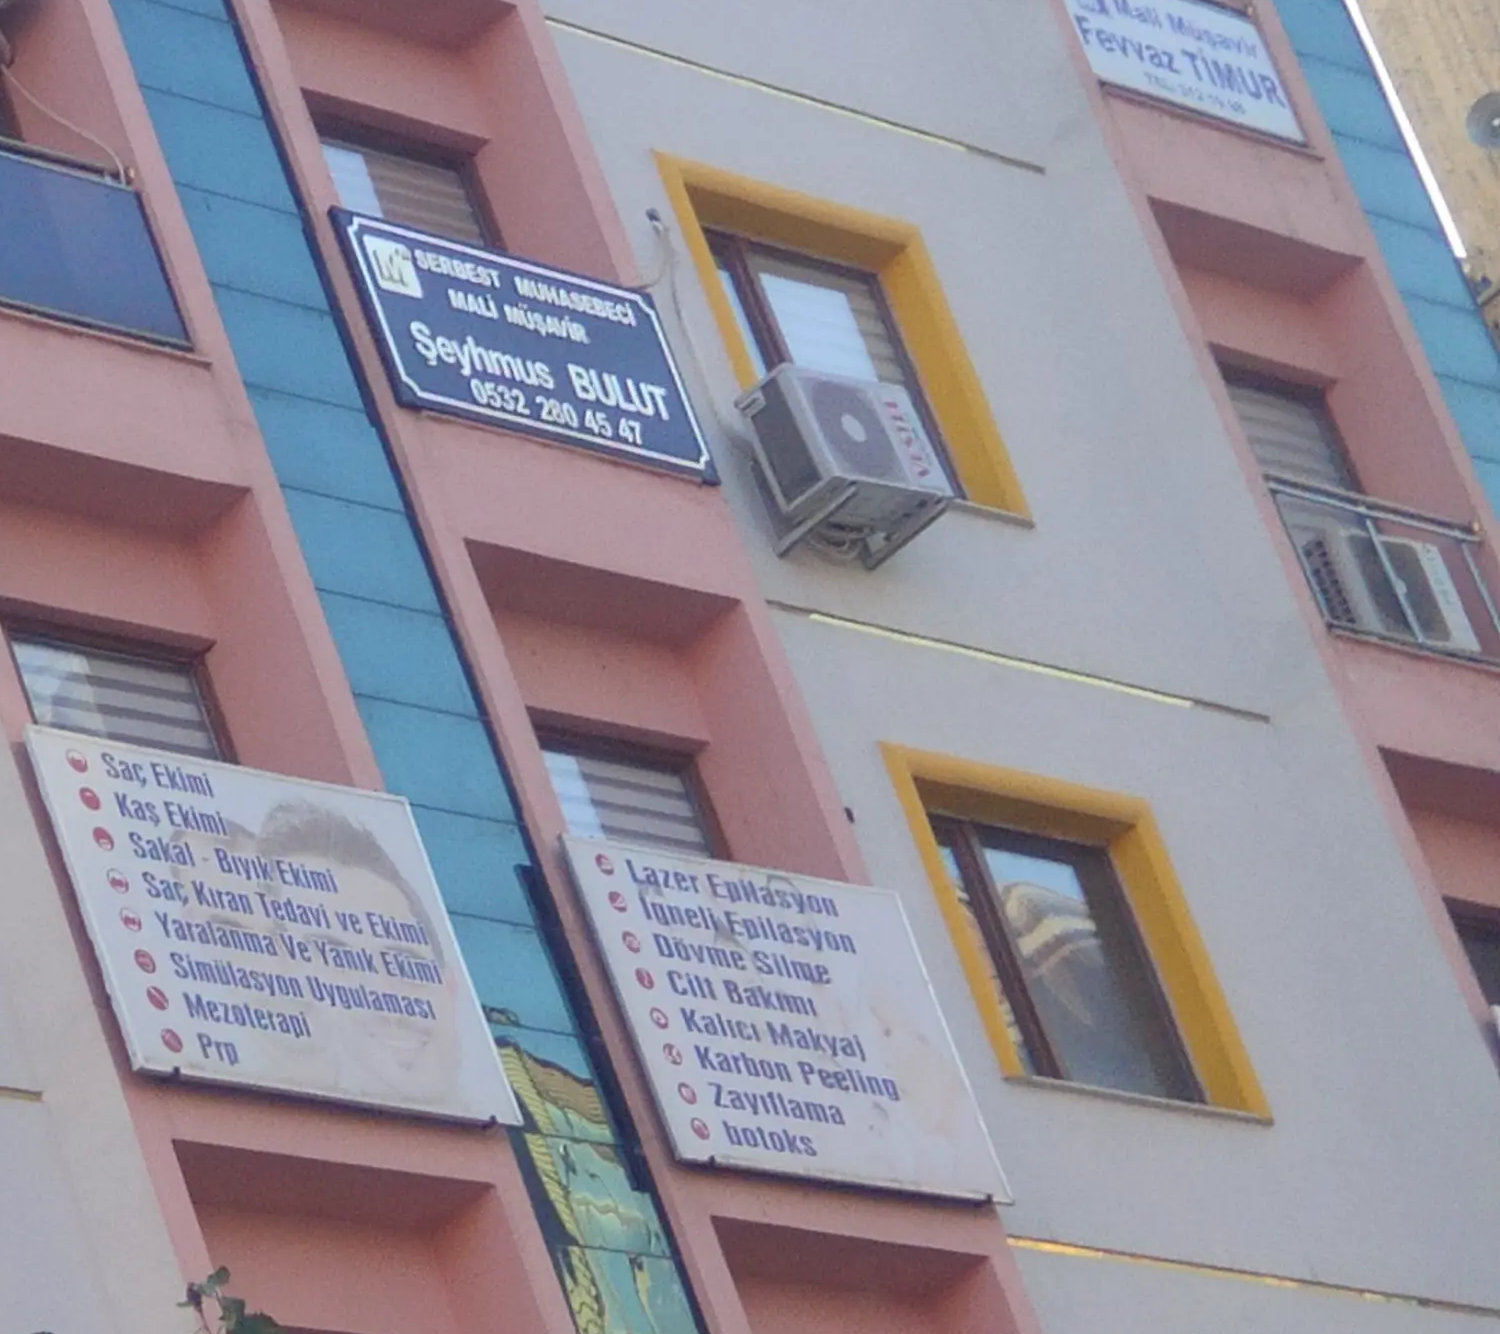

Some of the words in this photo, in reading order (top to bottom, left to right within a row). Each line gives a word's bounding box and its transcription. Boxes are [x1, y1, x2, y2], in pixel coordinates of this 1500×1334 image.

[414, 250, 500, 288] SERBEST
[515, 275, 637, 327] MUHASEBECİ
[448, 288, 498, 320] MALİ
[503, 304, 591, 344] MÜŞAVİR
[410, 321, 554, 389] Şeyhmus
[568, 364, 669, 421] BULUT
[471, 379, 530, 415] 0532
[585, 412, 611, 438] 45
[618, 420, 642, 445] 47
[101, 752, 147, 787] Saç
[155, 760, 215, 797] Ekimi
[114, 791, 160, 826] Kaş
[167, 800, 229, 836] Ekimi
[129, 831, 196, 867] Sakal
[215, 847, 274, 881] Bıyık
[276, 858, 338, 894] Ekimi
[626, 859, 700, 893] Lazer
[706, 872, 840, 917] Epilasyon
[143, 870, 189, 906] Saç
[196, 882, 254, 915] Kıran
[259, 891, 330, 931] Tedavi
[336, 910, 363, 934] ve
[366, 910, 429, 947] Ekimi
[724, 911, 858, 955] Epilasyon
[155, 911, 278, 957] Yaralanma
[281, 934, 309, 962] Ve
[314, 941, 376, 974] Yanık
[381, 949, 443, 985] Ekimi
[653, 933, 746, 970] Dövme
[754, 952, 832, 985] Silme
[170, 952, 302, 999] Simülasyon
[307, 976, 436, 1020] Uygulaması
[668, 970, 716, 999] Cilt
[724, 979, 818, 1016] Bakımı
[183, 991, 311, 1038] Mezoterapi
[681, 1007, 759, 1042] Kalıcı
[767, 1023, 865, 1063] Makyaj
[198, 1033, 241, 1066] Prp
[694, 1045, 792, 1083] Karbon
[799, 1061, 901, 1101] Peeling
[708, 1081, 846, 1126] Zayıflama
[723, 1121, 818, 1157] botoks
